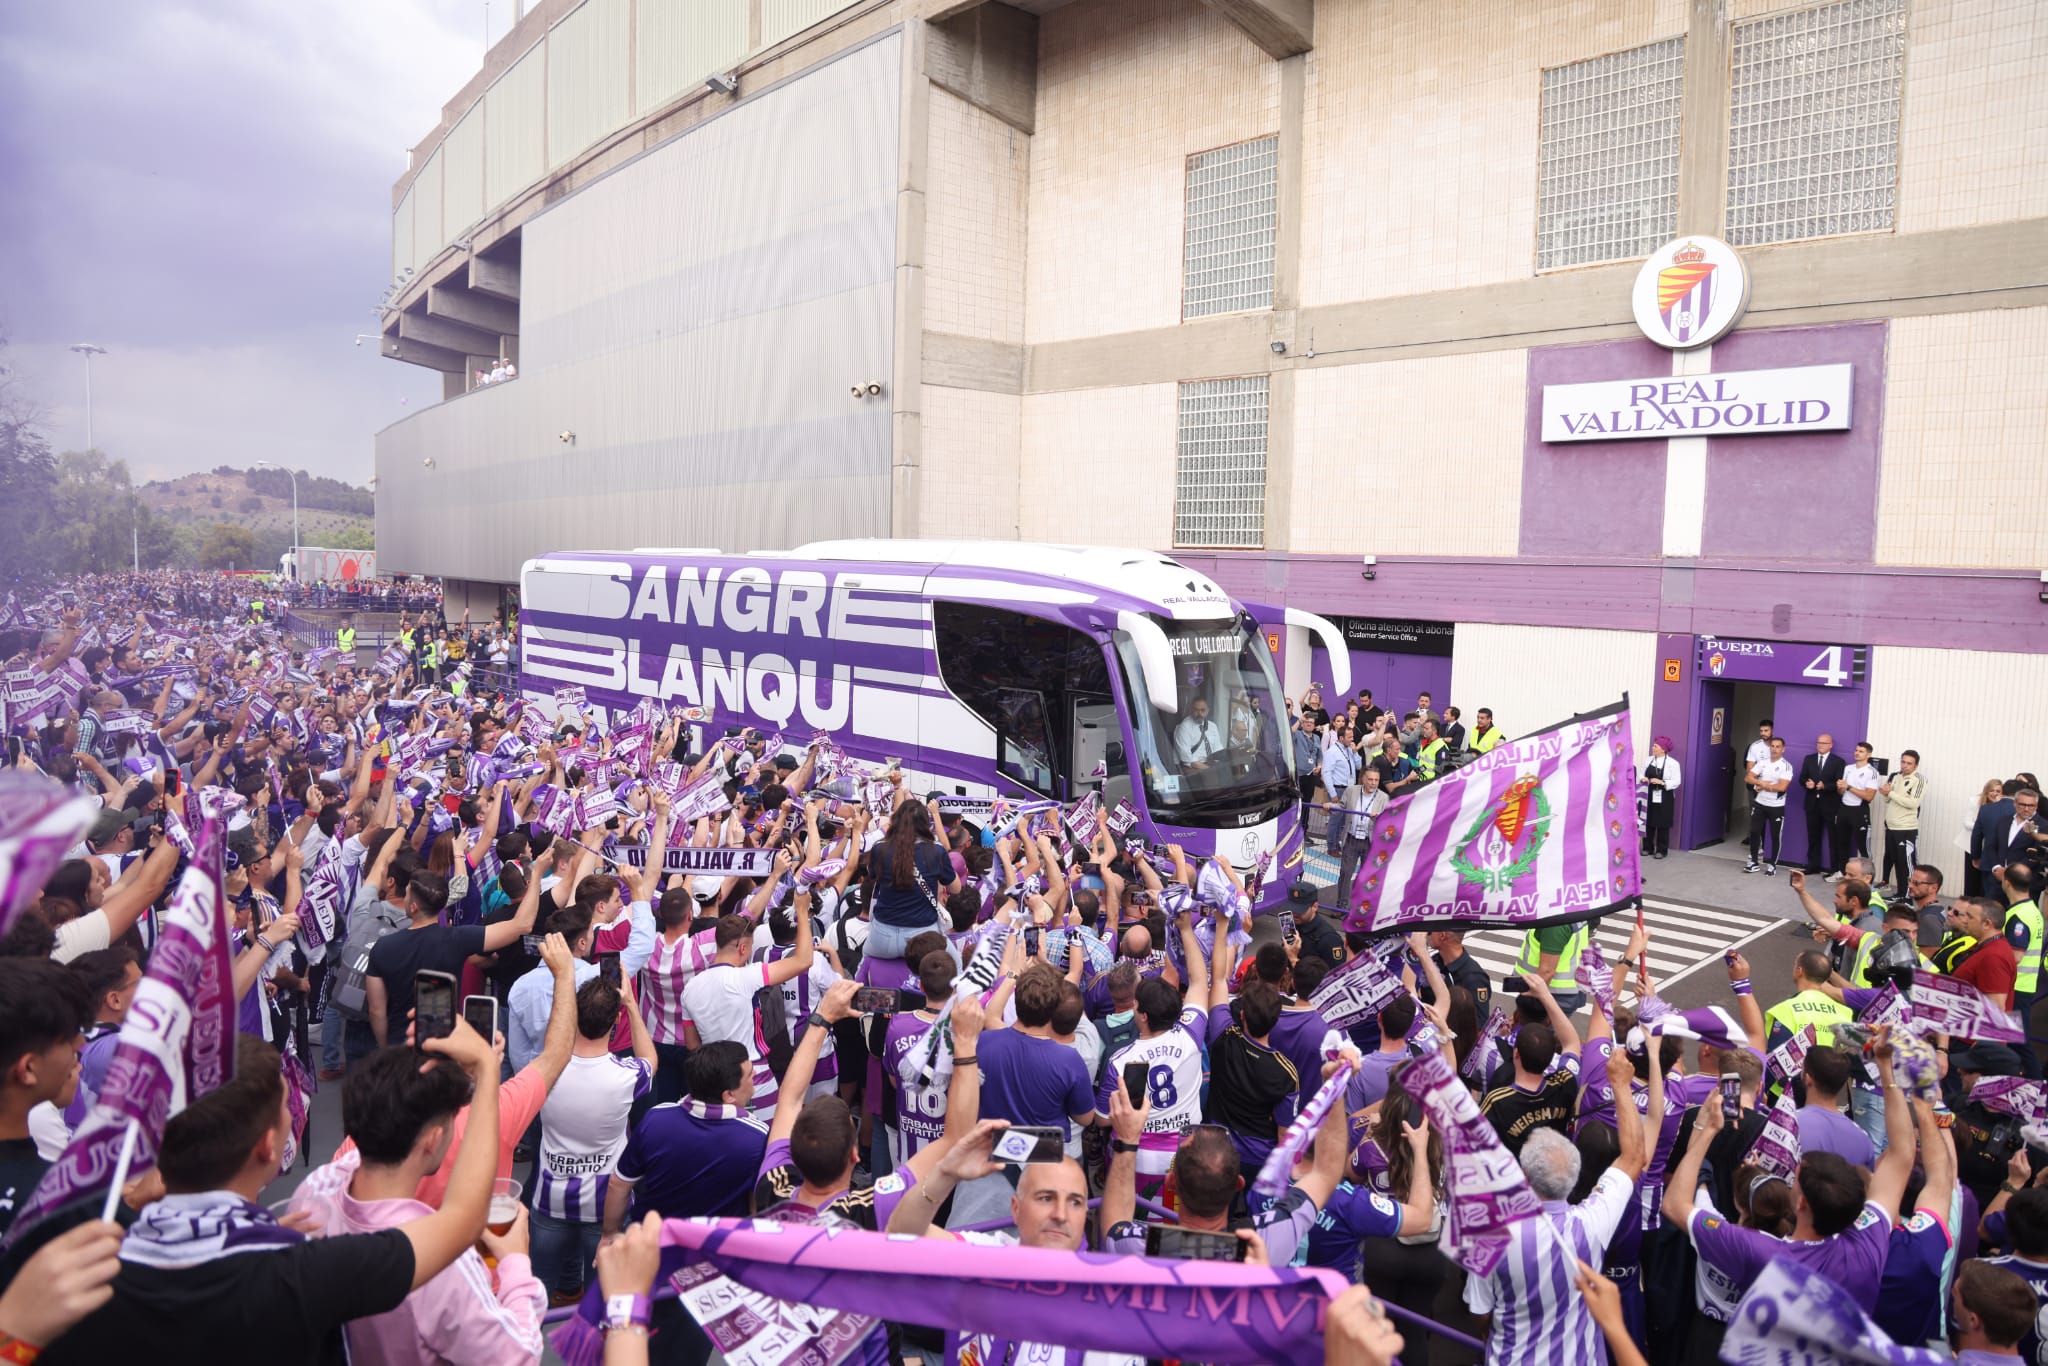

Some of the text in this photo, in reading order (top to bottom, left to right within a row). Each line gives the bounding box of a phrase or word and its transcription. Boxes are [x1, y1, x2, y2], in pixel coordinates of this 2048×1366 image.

[1629, 378, 1740, 410] REAL
[1559, 399, 1831, 436] VALLADOLID
[550, 559, 910, 649] SANGRE
[1348, 620, 1377, 631] Oficina
[1415, 624, 1425, 634] al
[1348, 630, 1418, 641] Customer Service Office
[1170, 635, 1242, 656] REAL VALLADOLID
[1706, 641, 1774, 654] PUERTA
[1802, 646, 1848, 687] 4
[1792, 1002, 1837, 1015] EULEN
[1147, 1064, 1178, 1111] 8
[1507, 1107, 1567, 1137] WEISSMAN
